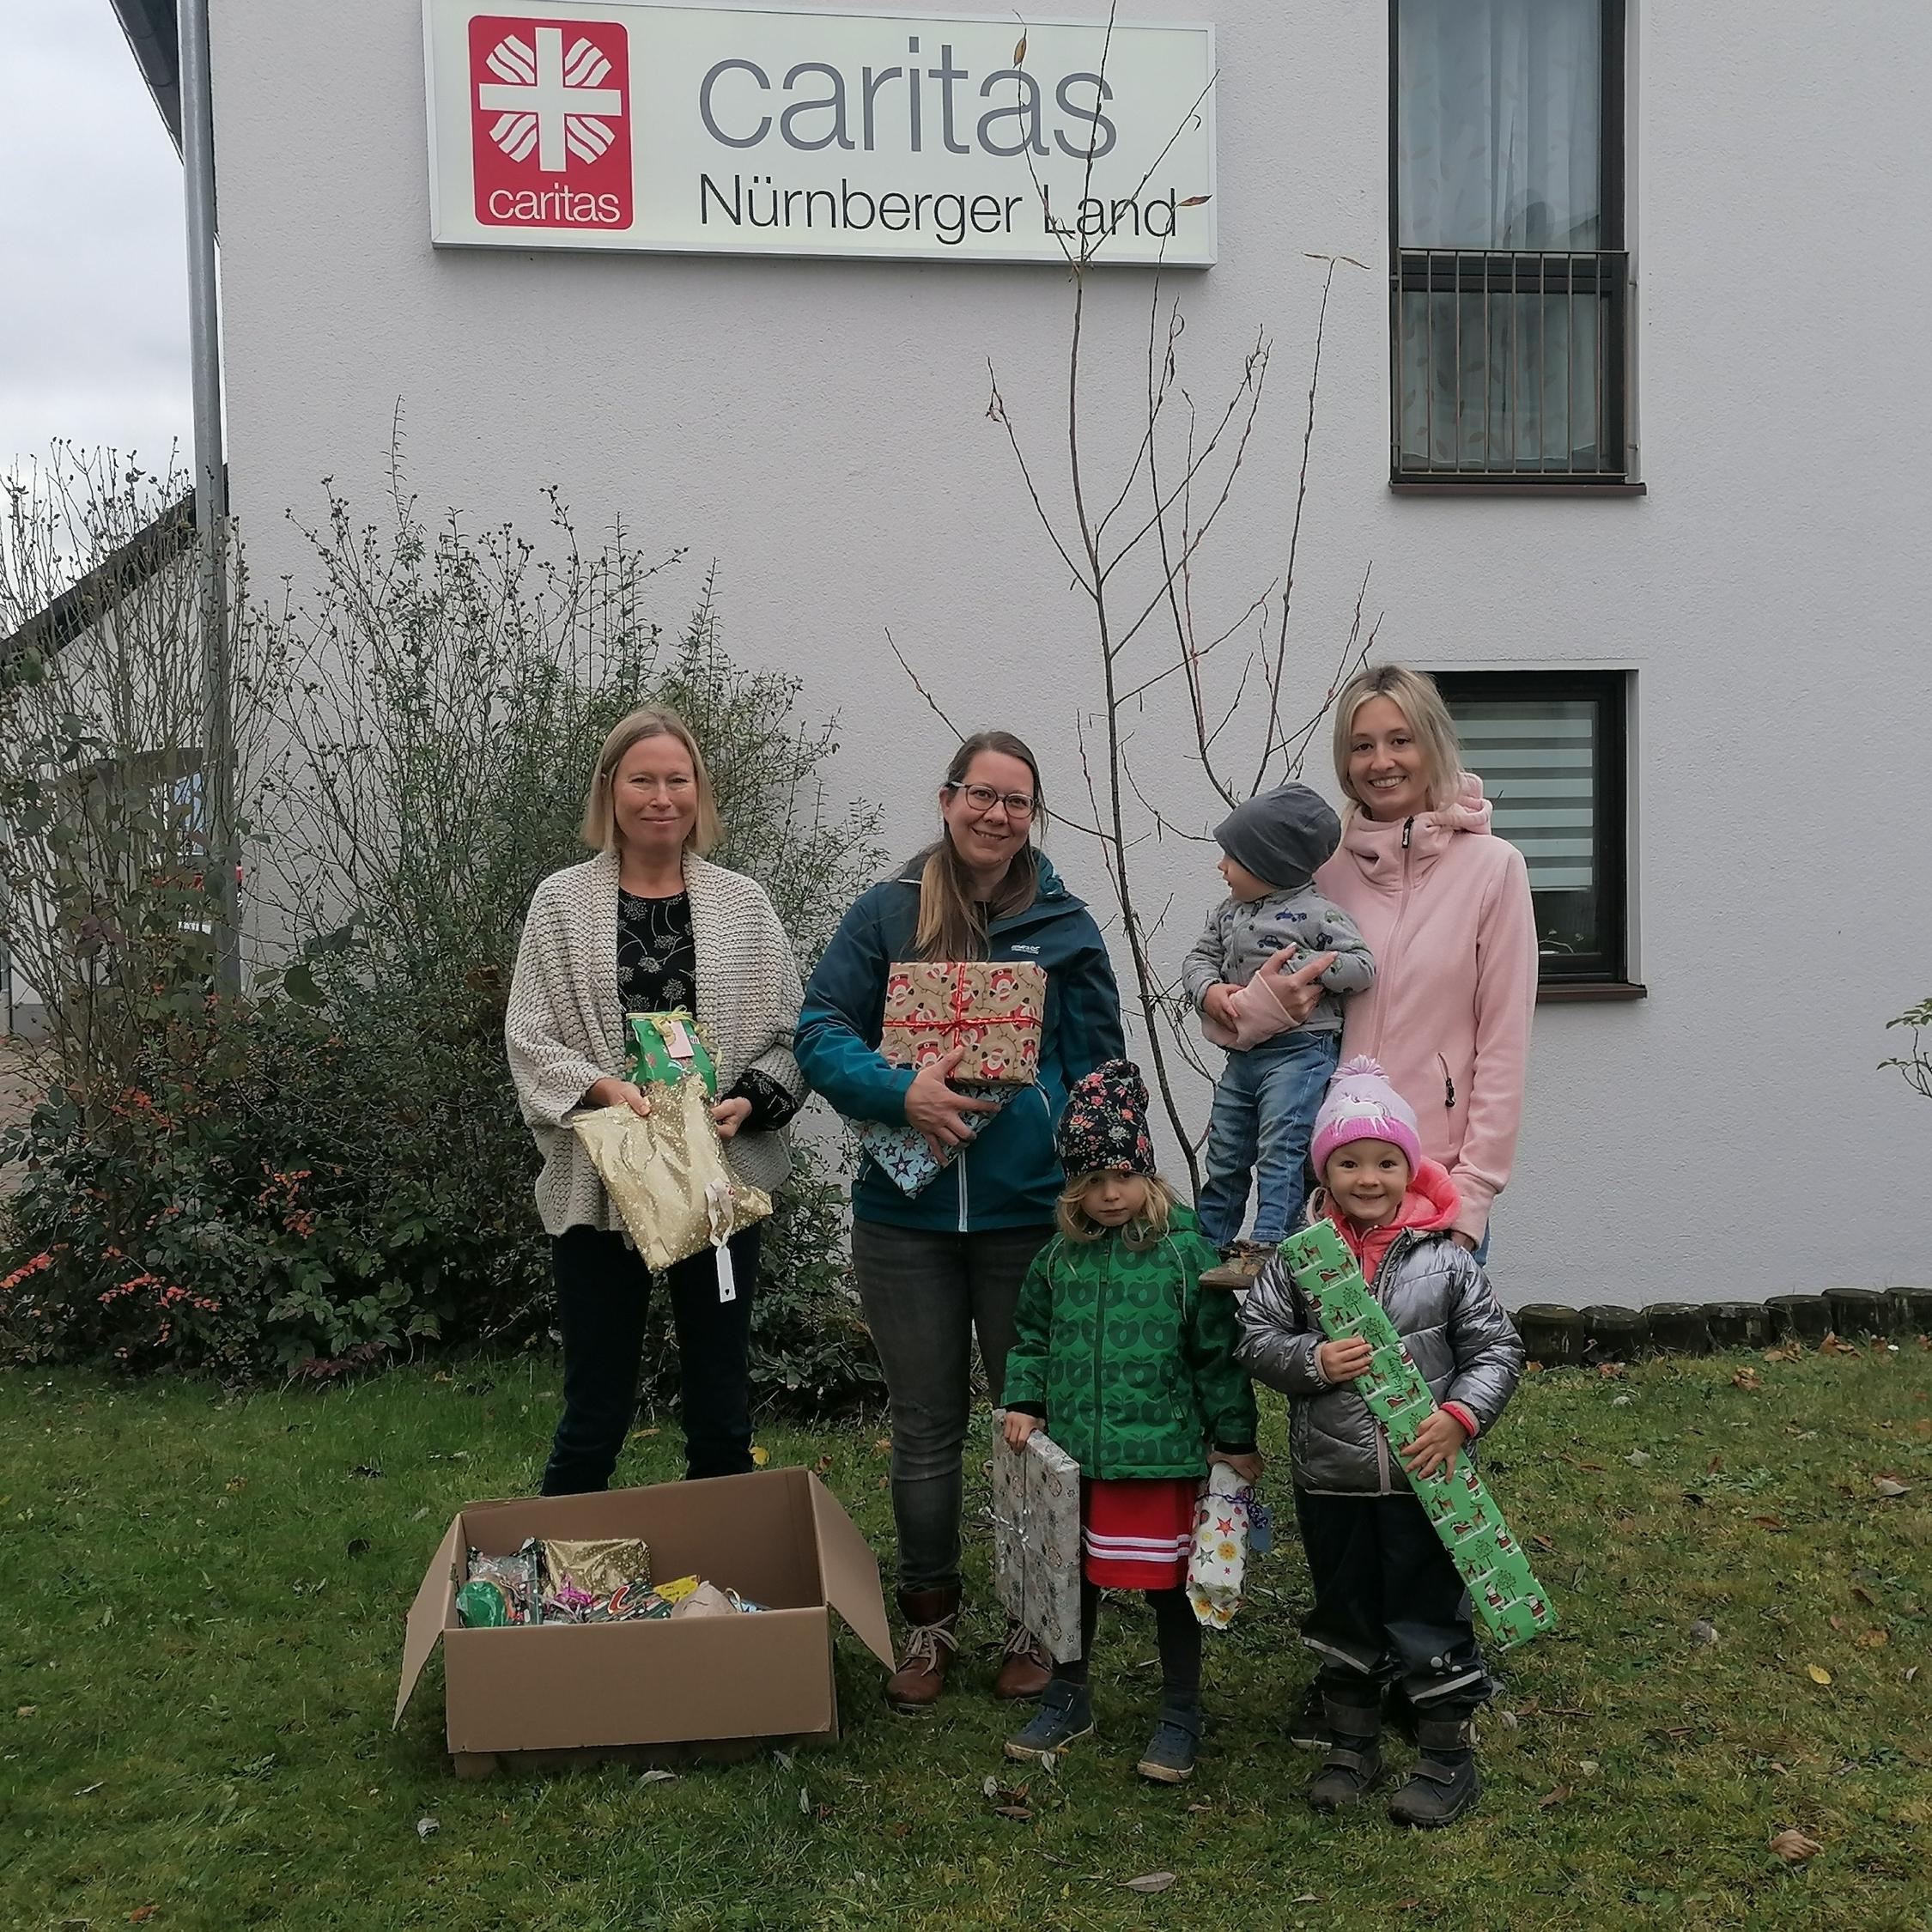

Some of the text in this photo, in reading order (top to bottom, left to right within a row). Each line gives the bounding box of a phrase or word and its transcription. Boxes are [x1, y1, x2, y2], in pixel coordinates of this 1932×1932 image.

[699, 36, 1117, 160] caritas
[488, 182, 621, 224] caritas
[700, 173, 1177, 245] Nürnberger Land
